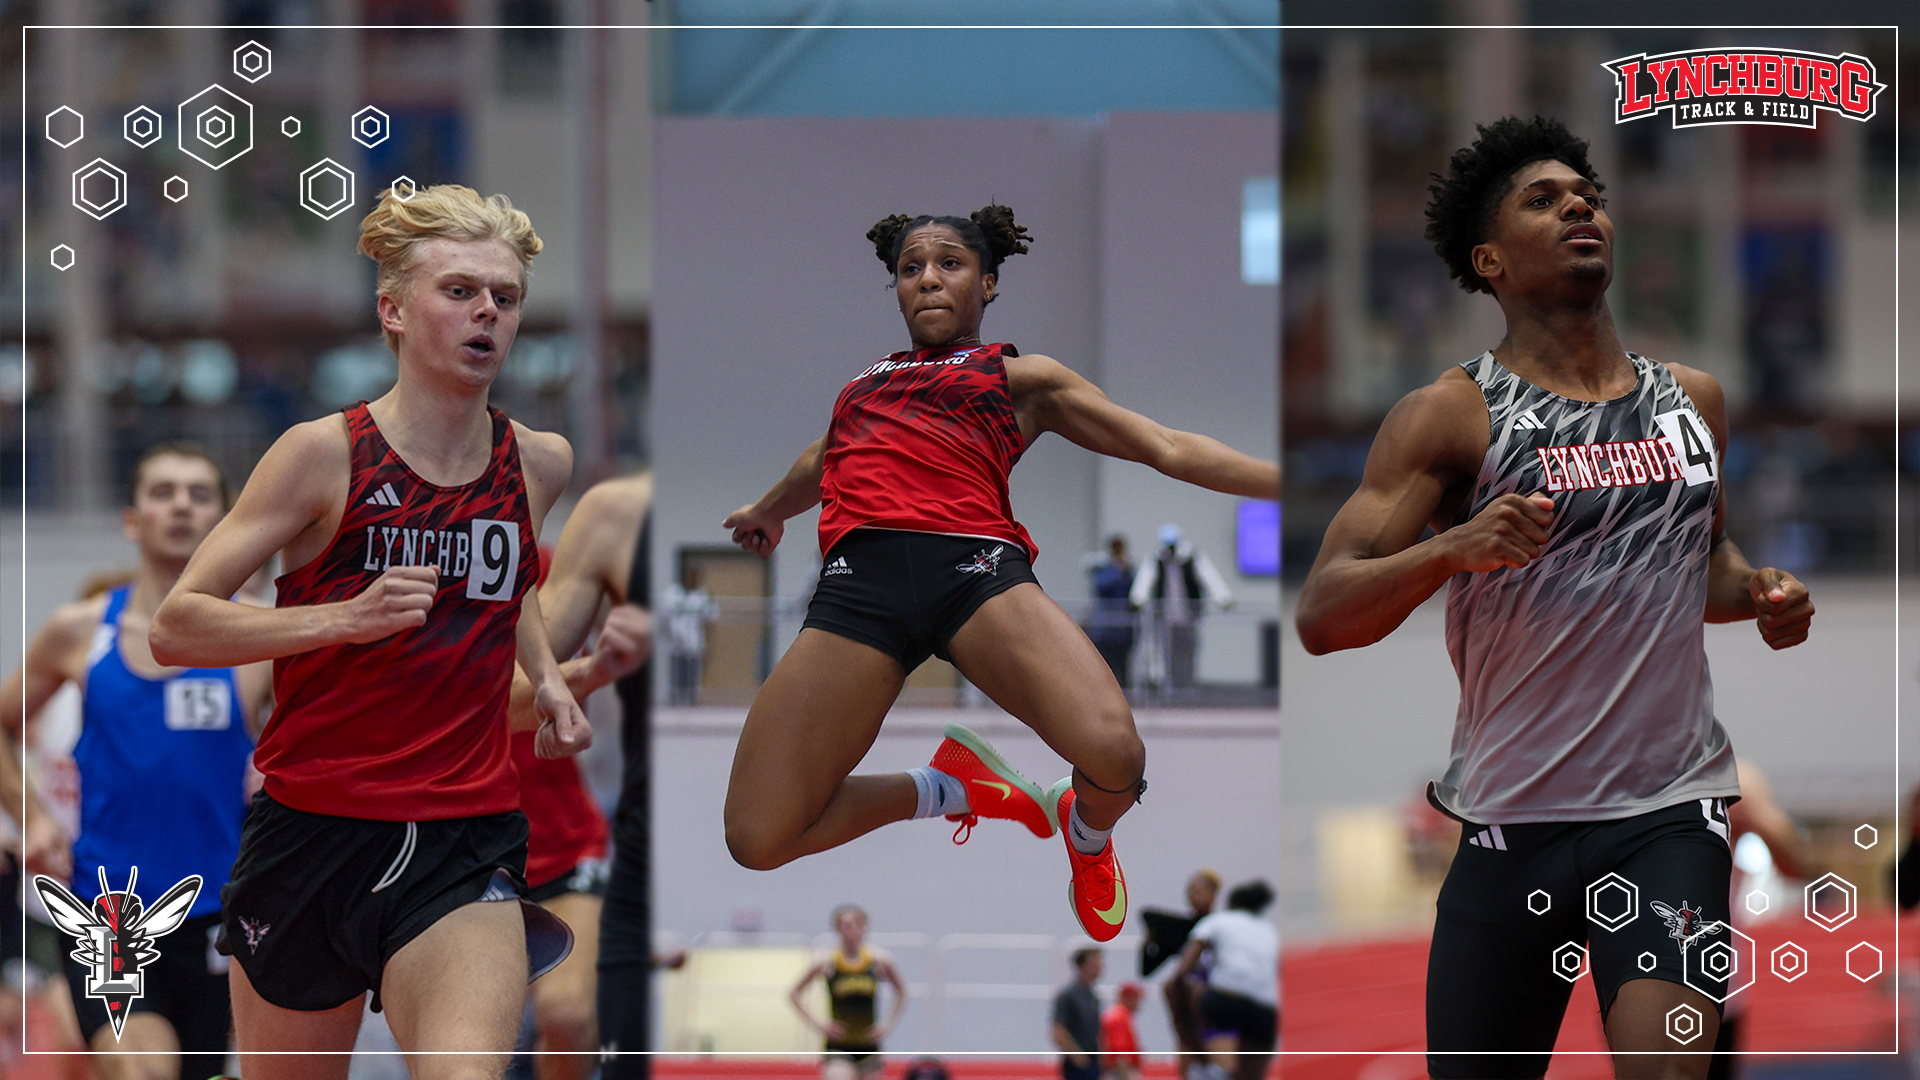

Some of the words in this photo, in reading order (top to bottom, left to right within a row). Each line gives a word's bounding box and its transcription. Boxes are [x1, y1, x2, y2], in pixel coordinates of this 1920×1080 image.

[1677, 413, 1713, 477] 4
[480, 523, 510, 596] 9
[824, 566, 853, 577] adidas
[183, 684, 221, 725] 15
